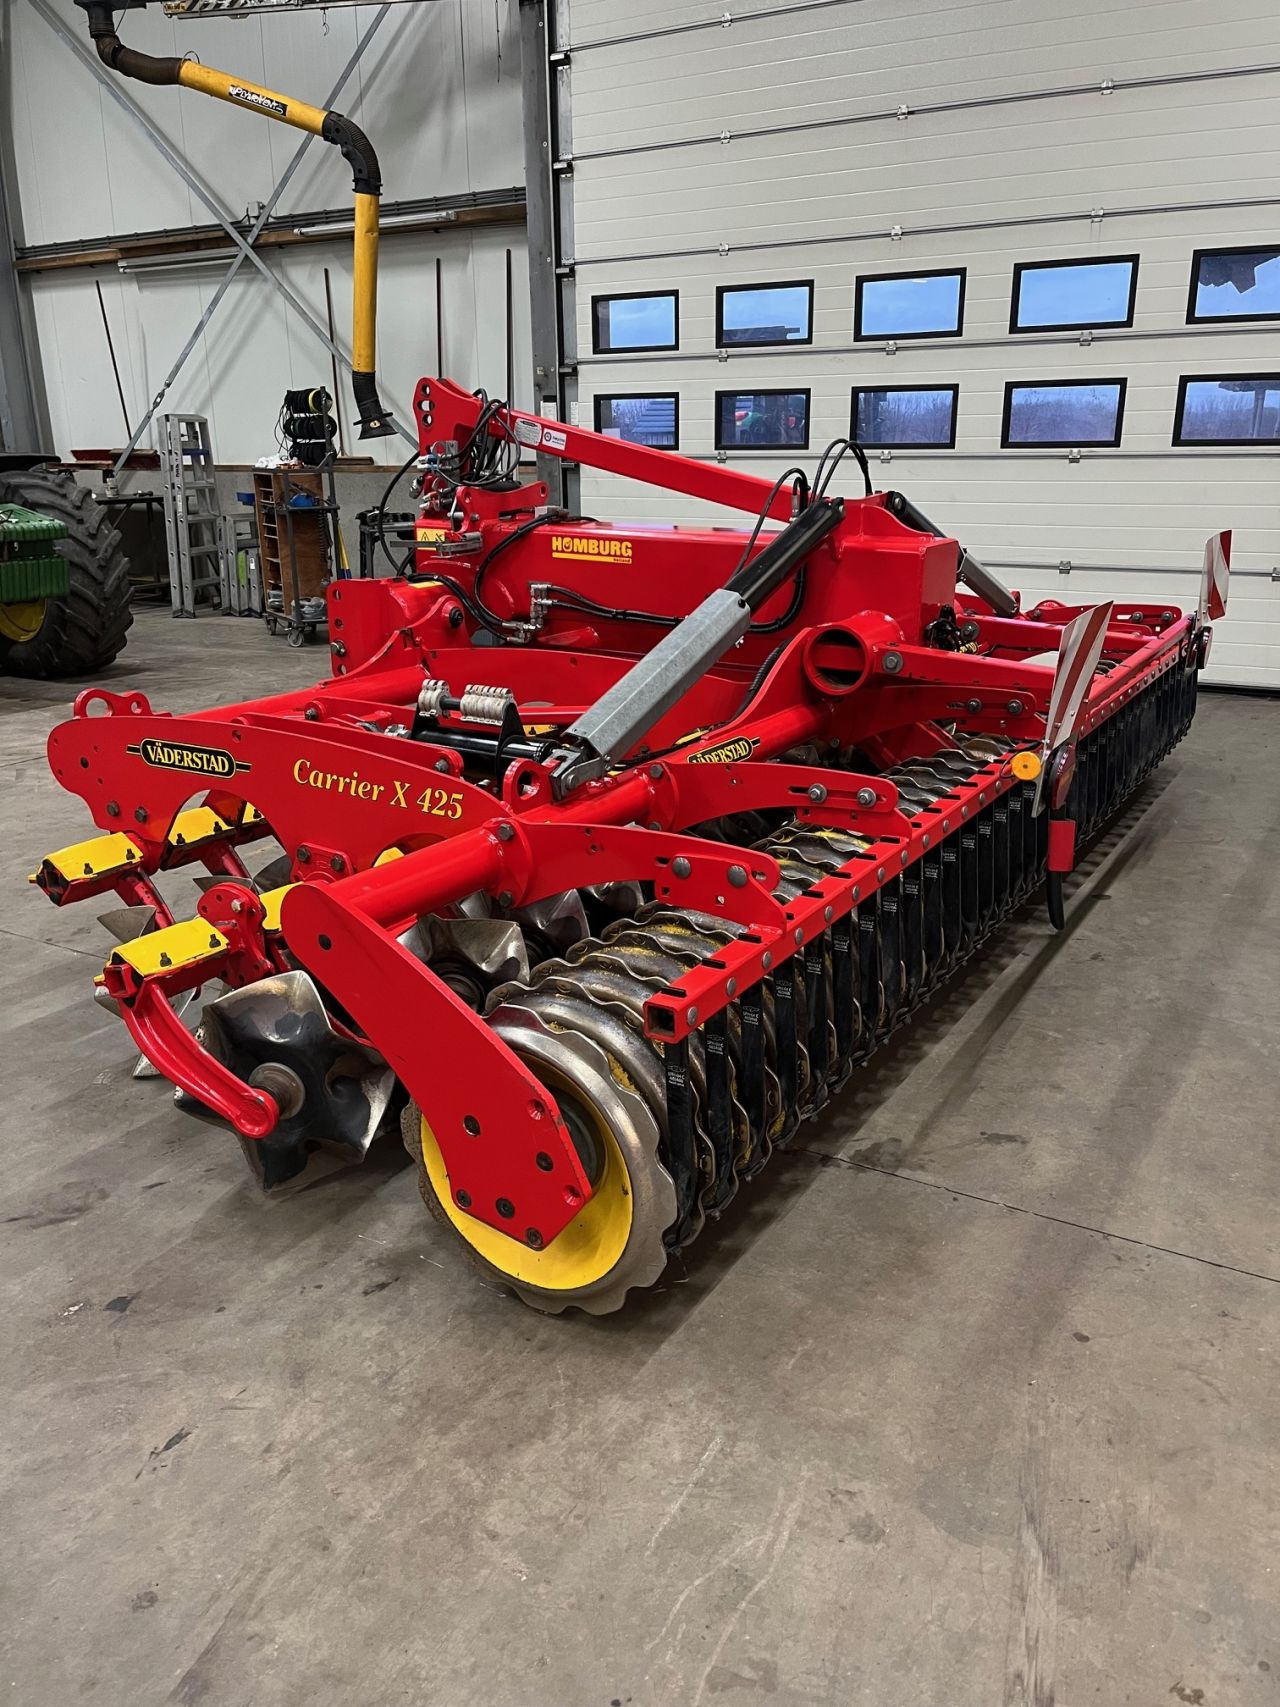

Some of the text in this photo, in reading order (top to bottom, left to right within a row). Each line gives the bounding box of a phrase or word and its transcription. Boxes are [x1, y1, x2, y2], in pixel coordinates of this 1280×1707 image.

[552, 536, 632, 557] HOMBURG
[146, 742, 229, 773] VÄDERSTAD
[692, 741, 750, 763] ÄDERSTAD
[293, 759, 464, 819] Carrier X 425
